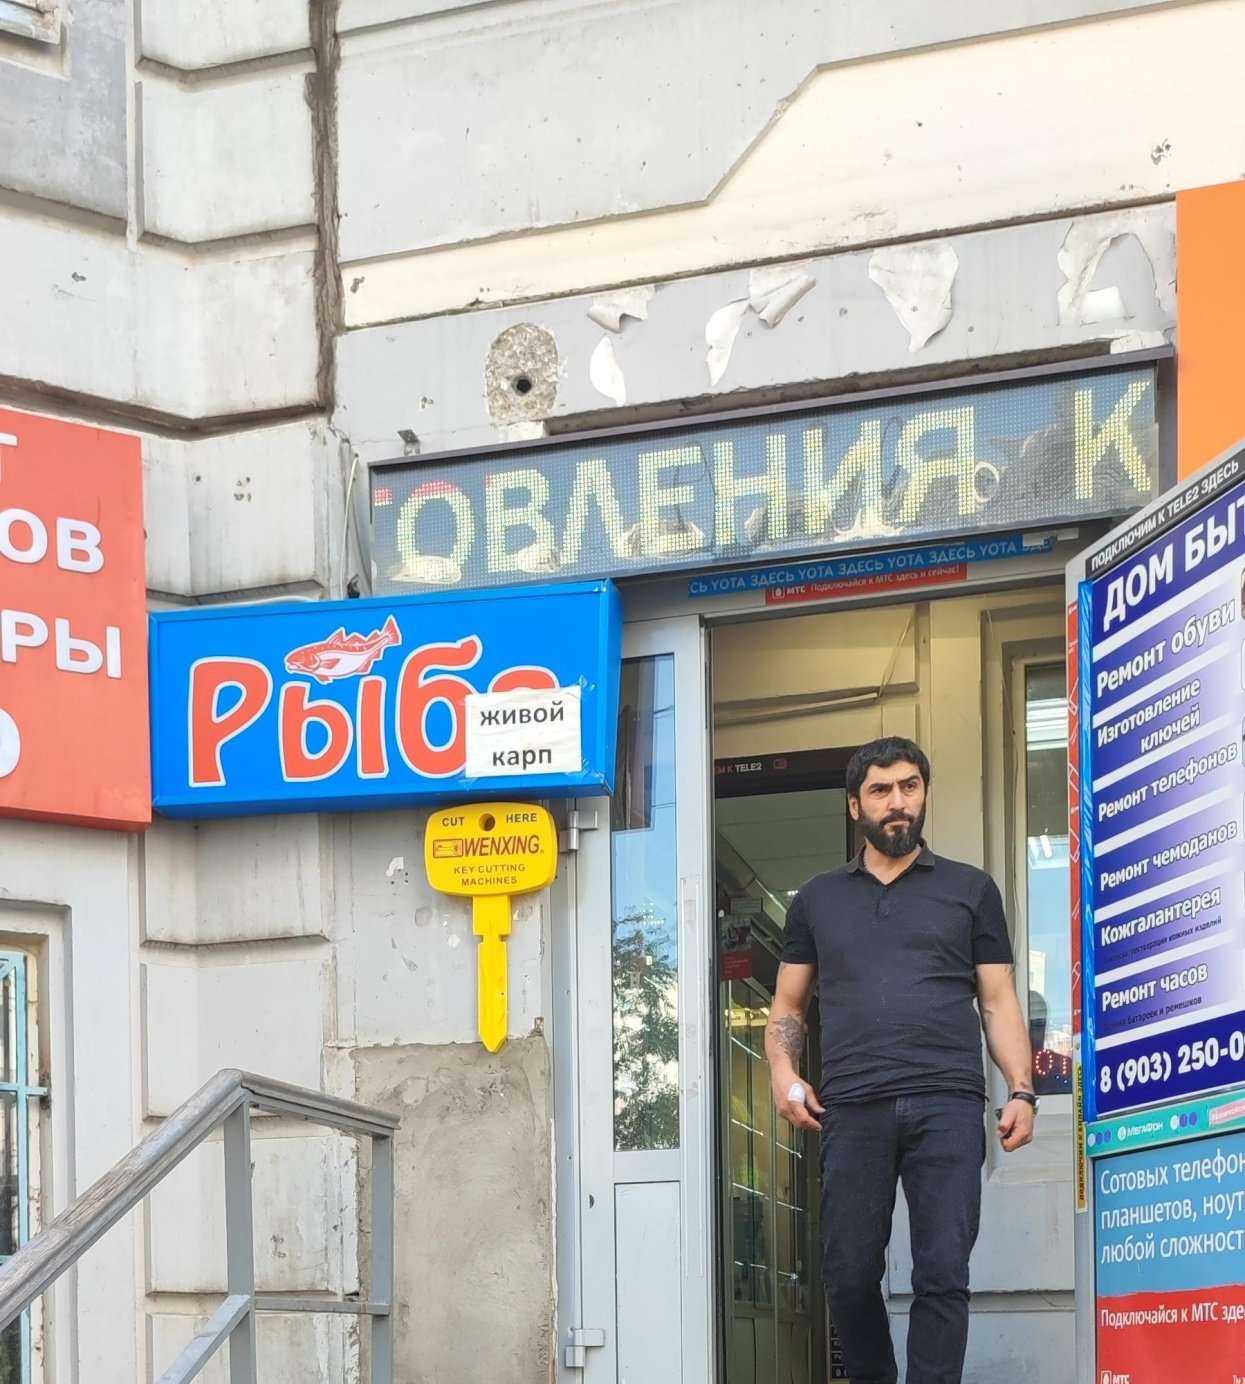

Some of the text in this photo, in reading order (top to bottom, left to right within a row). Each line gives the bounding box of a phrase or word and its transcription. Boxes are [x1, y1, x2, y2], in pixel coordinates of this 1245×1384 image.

[374, 405, 975, 584] ОВЛЕНИЯ
[1091, 460, 1239, 572] ПОДКЛЮЧИМ К TELE2 ЗДЕСЬ
[711, 574, 746, 592] YOTA
[751, 570, 795, 588] ЗДЕСЬ
[799, 564, 833, 581] YOTA
[838, 559, 884, 577] ЗДЕСЬ
[887, 553, 925, 570] YOTA
[928, 547, 976, 566] ЗДЕСЬ
[978, 541, 1017, 557] YOTA
[786, 585, 806, 596] МТС
[1103, 543, 1174, 633] ДОМ
[0, 608, 122, 679] РЫ
[1097, 599, 1237, 698] Ремонт обуви
[188, 634, 562, 789] Рыб
[479, 699, 566, 727] живой
[1097, 678, 1201, 748] Изготовление
[1140, 702, 1201, 753] ключей
[491, 744, 554, 772] карп
[1098, 742, 1239, 823] Ремонт телефонов
[441, 812, 538, 828] CUT HERE
[453, 863, 526, 876] KEY CUTTING
[464, 834, 541, 858] WENXING
[1100, 821, 1239, 892] Ремонт чемоданов
[461, 875, 518, 888] MACHINES
[1101, 887, 1222, 947] Кожгалантерея
[1102, 963, 1209, 1012] Ремонт часов
[1100, 1030, 1245, 1094] 8 (903) 250-0
[1100, 1165, 1169, 1195] Сотовых
[1101, 1190, 1245, 1230] планшетов, ноут
[1101, 1229, 1245, 1265] любой сложност
[1101, 1302, 1245, 1329] Подключайся к МТС зде
